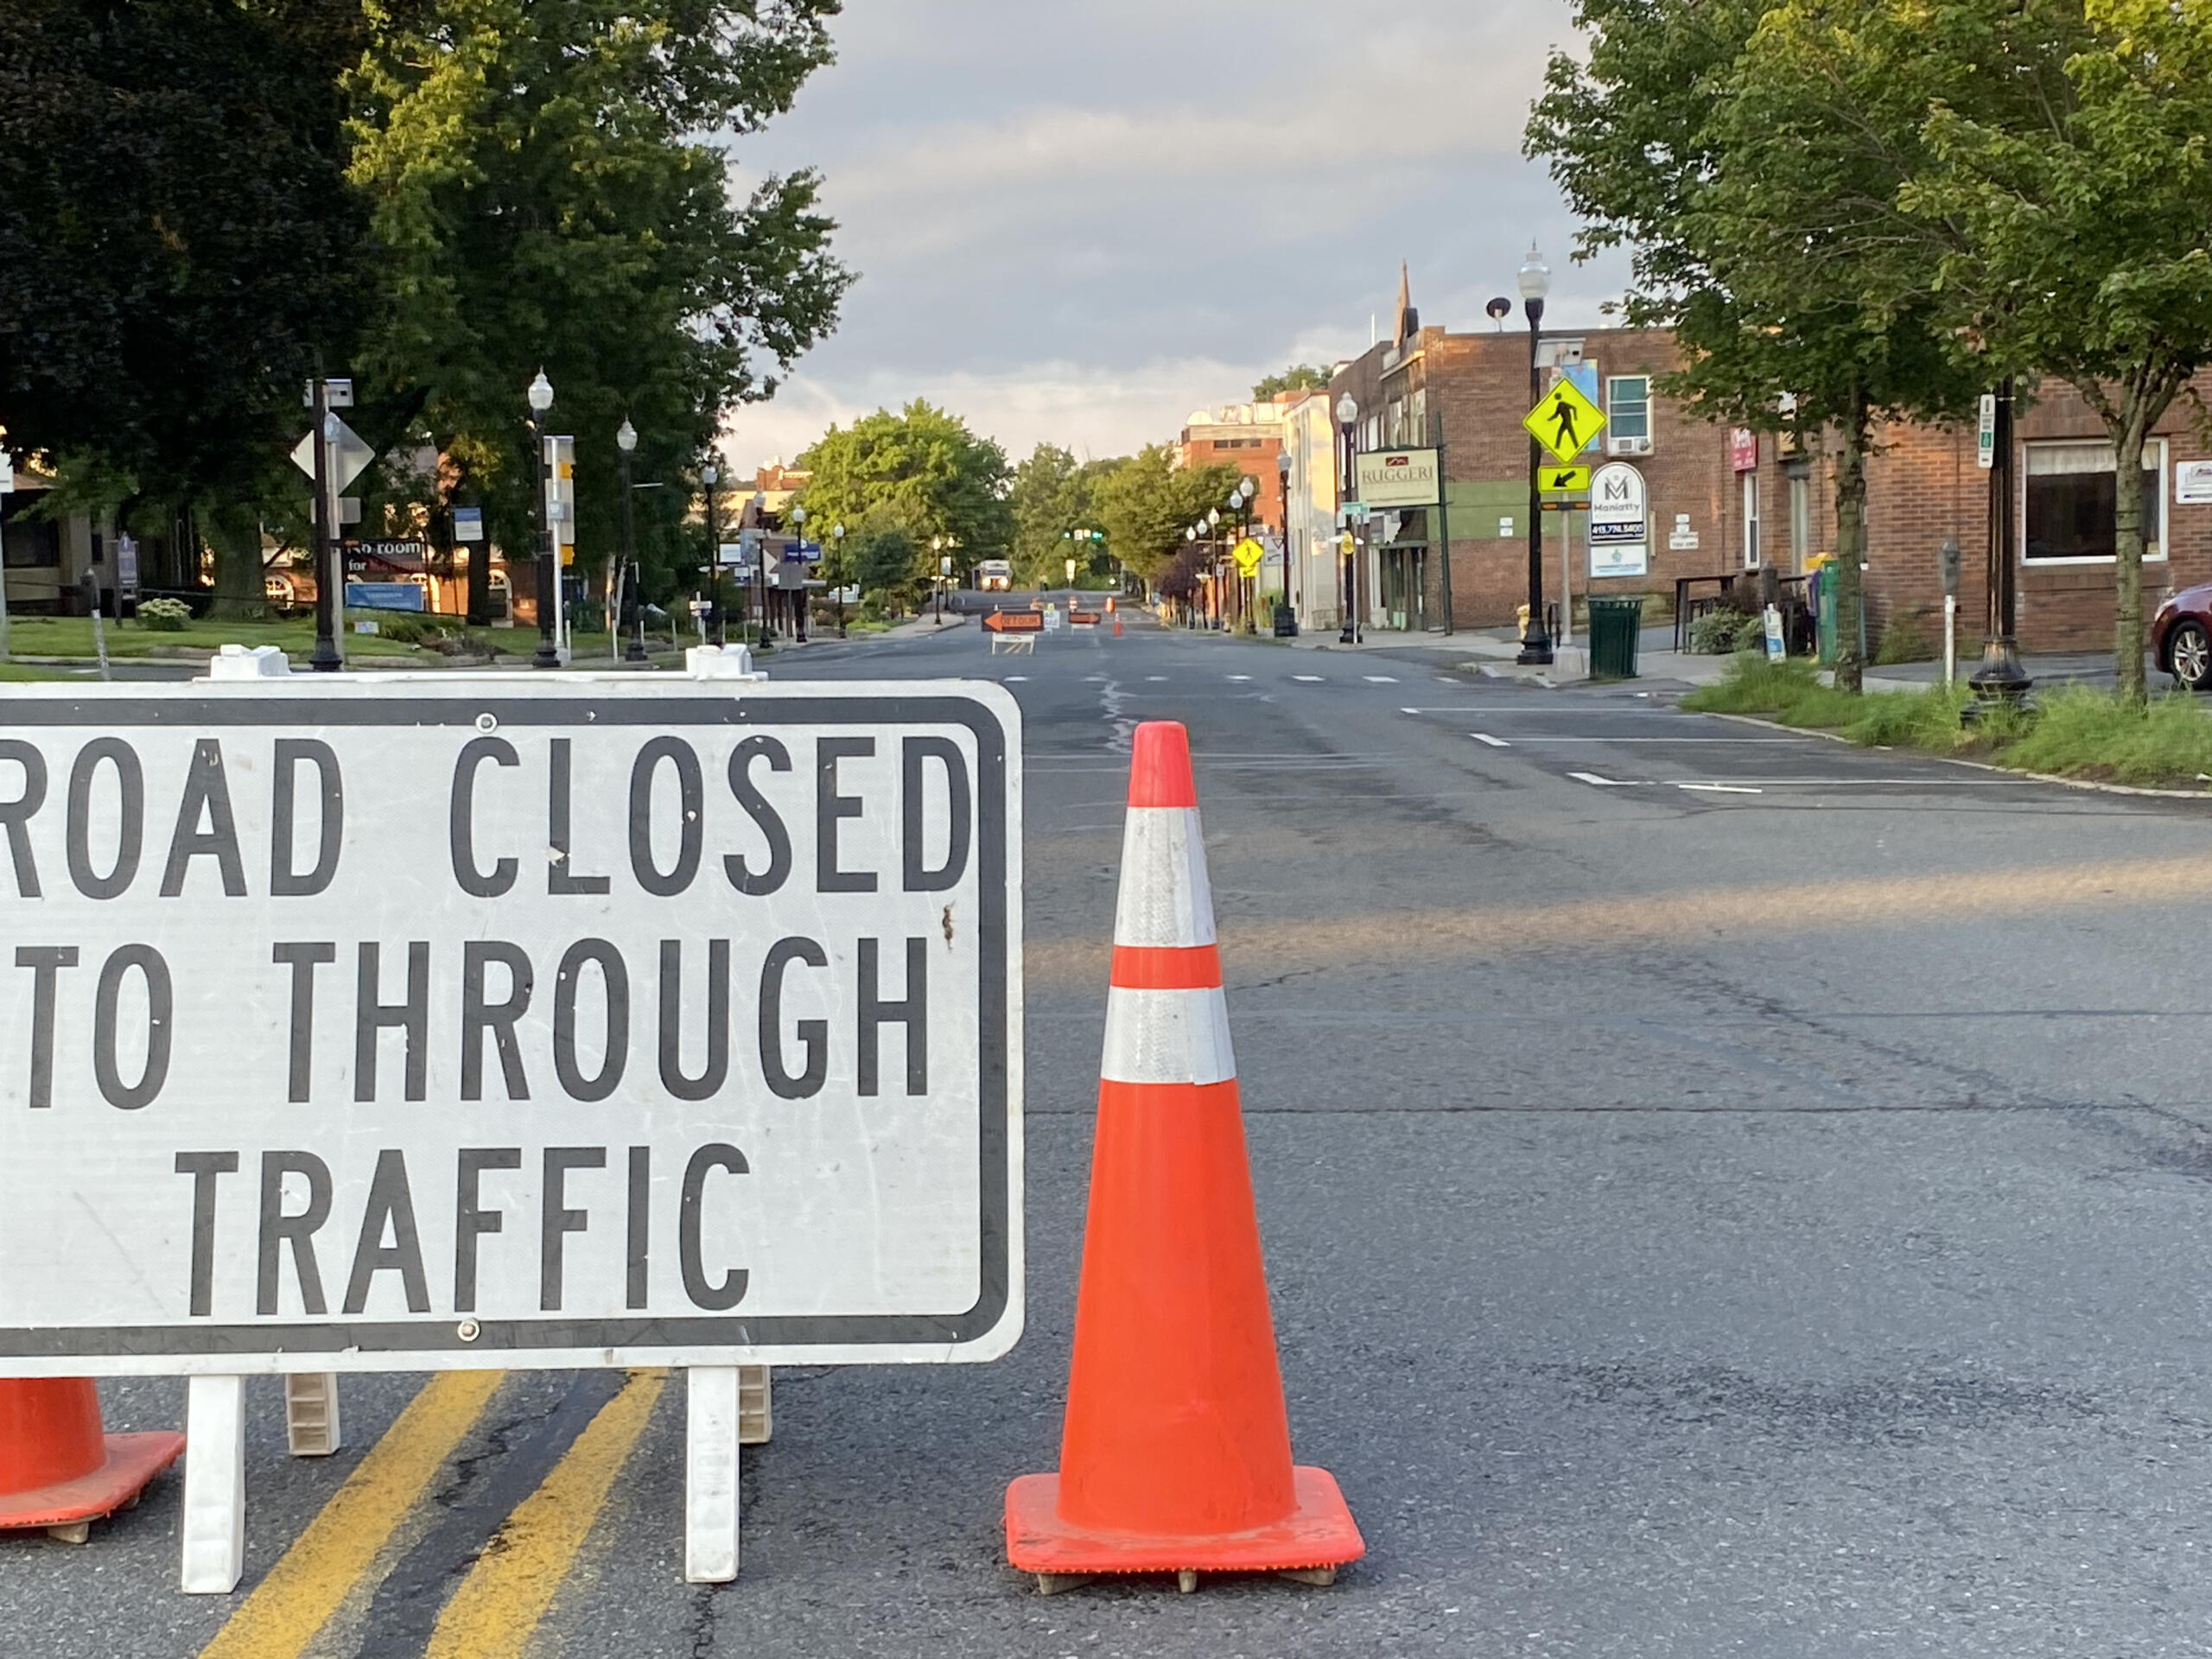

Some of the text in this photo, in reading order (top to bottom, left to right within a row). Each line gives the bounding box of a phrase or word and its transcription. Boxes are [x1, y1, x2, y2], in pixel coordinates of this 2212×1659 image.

[1362, 466, 1433, 483] RUGGERI
[1594, 503, 1640, 512] Maniatty
[377, 542, 422, 554] room
[348, 559, 366, 571] for
[0, 734, 971, 899] ROAD CLOSED
[15, 937, 928, 1109] TO THROUGH
[175, 1142, 750, 1317] TRAFFIC
